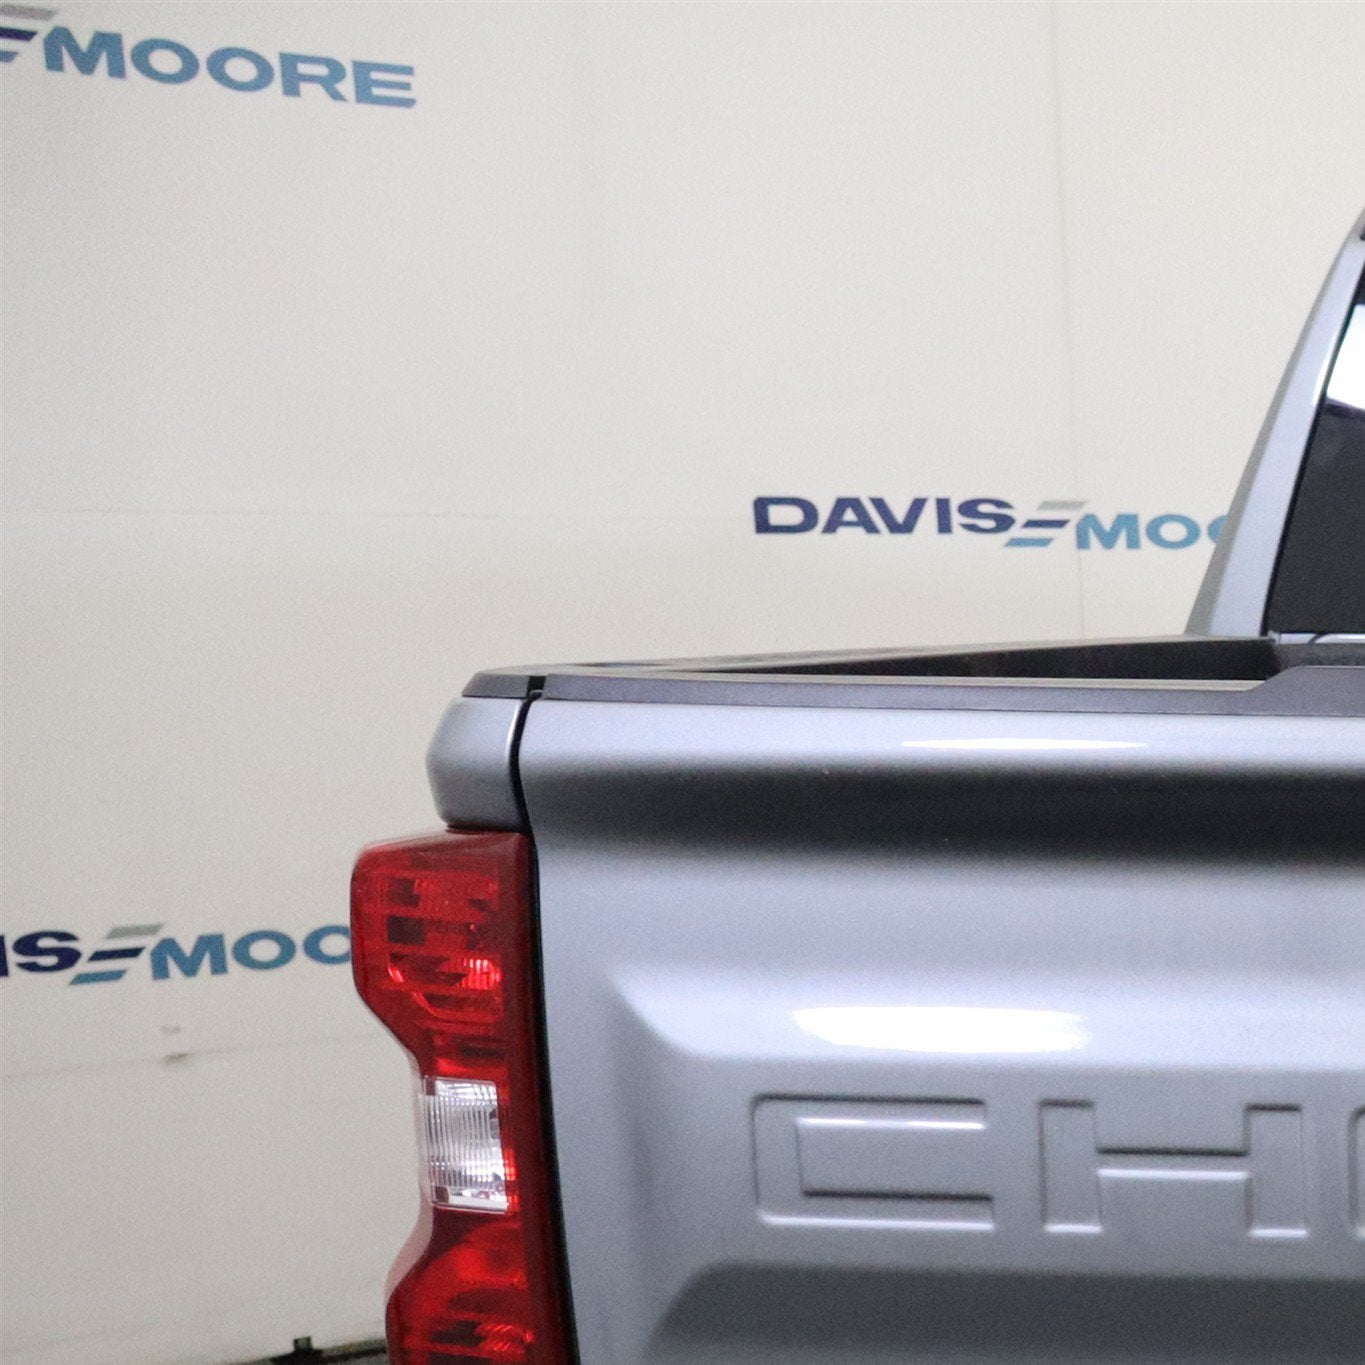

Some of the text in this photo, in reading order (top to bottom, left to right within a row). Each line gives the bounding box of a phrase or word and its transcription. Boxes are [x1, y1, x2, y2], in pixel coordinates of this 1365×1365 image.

[43, 26, 417, 109] MOORE
[752, 496, 1016, 534] DAVIS
[150, 924, 352, 981] MOO
